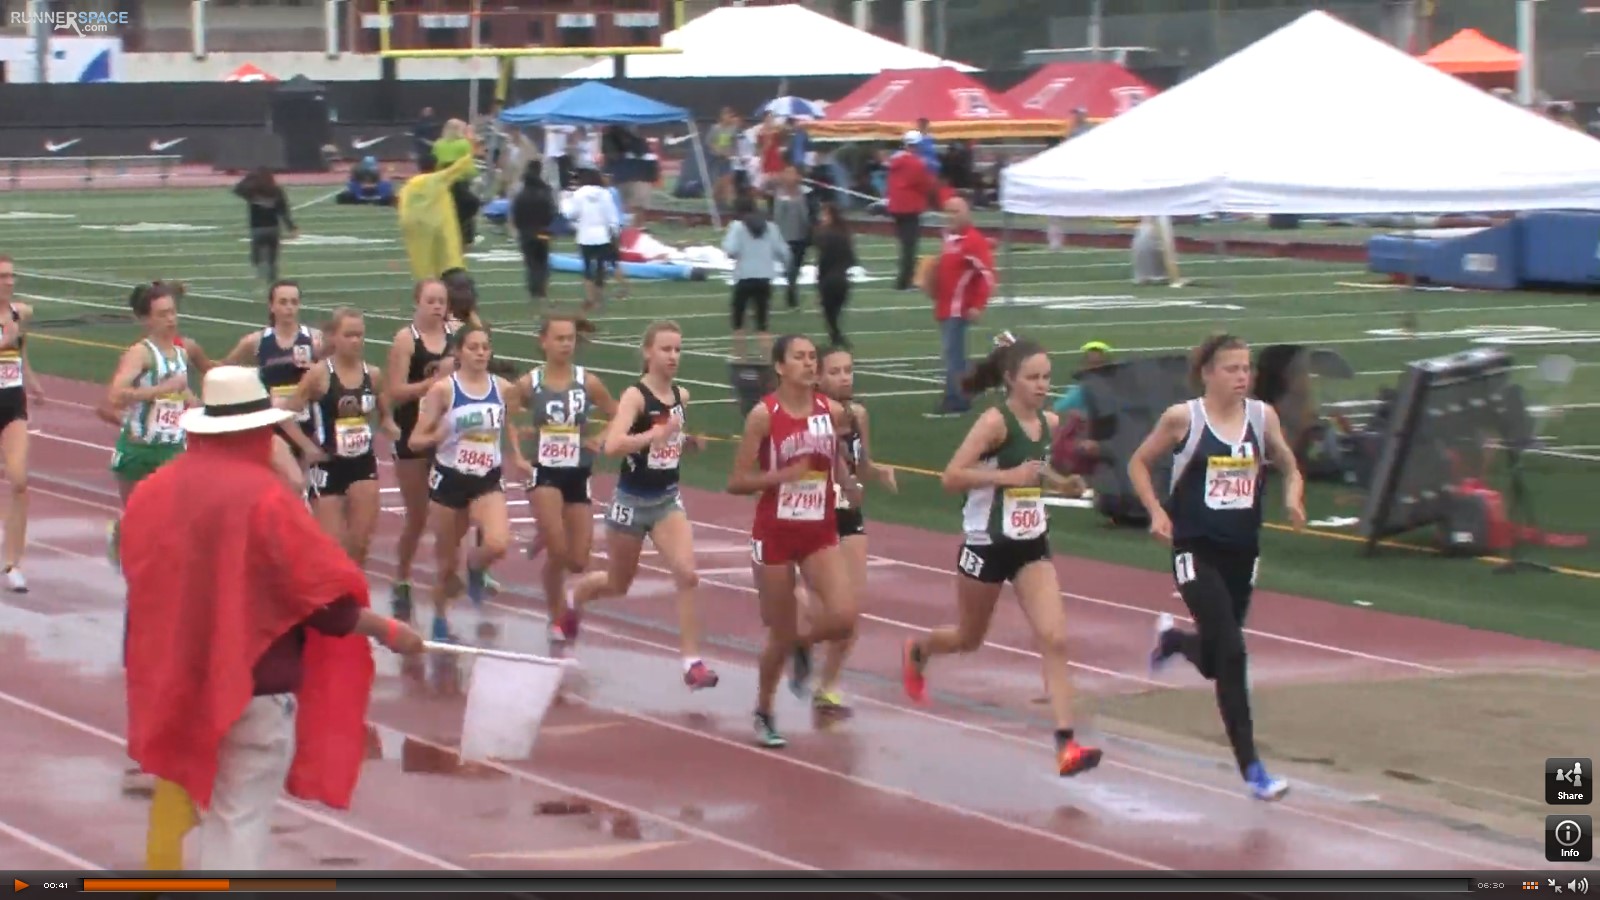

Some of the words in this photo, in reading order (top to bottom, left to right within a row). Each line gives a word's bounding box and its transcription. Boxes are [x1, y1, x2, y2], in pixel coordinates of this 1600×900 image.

[457, 449, 493, 468] 3845
[541, 443, 578, 459] 2847
[1208, 479, 1252, 497] 2740
[616, 504, 630, 523] 15
[1011, 509, 1040, 529] 600
